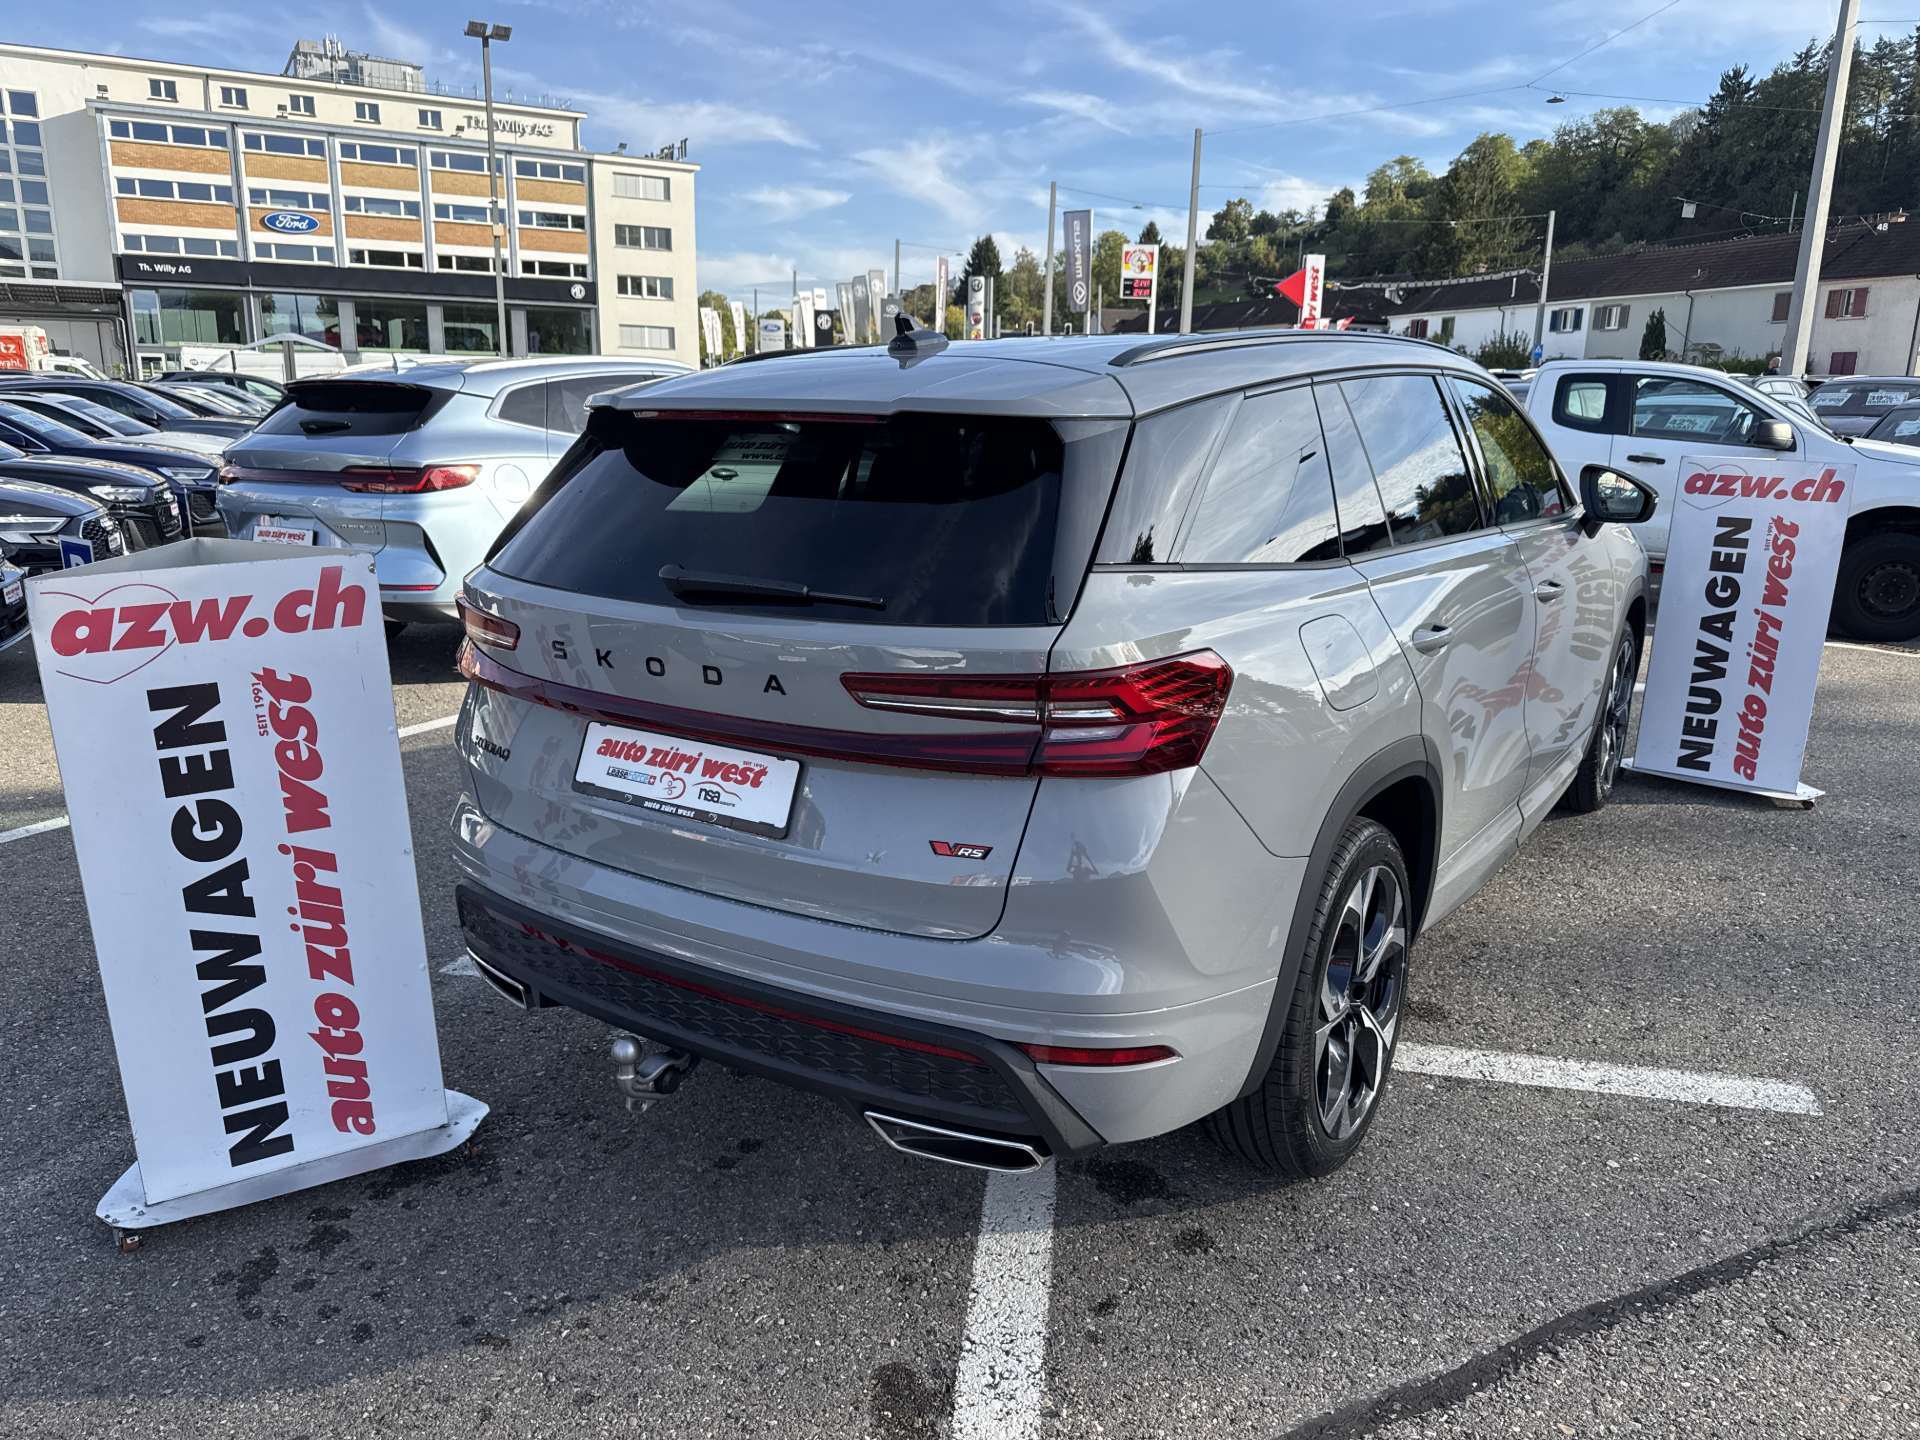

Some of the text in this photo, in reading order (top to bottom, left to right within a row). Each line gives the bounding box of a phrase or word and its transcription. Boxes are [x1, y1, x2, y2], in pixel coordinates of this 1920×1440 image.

[494, 119, 526, 138] Willy
[275, 214, 310, 230] Ford
[1876, 222, 1889, 231] 48
[138, 262, 192, 275] Th. Willy AG
[1684, 469, 1845, 503] azw.ch
[50, 565, 367, 657] azw.ch
[551, 639, 787, 696] SKODA
[1677, 516, 1753, 772] NEUWAGEN
[1733, 514, 1800, 782] auto züri west
[252, 681, 269, 737] SEIT 1991
[596, 738, 769, 789] auto züri west
[643, 800, 661, 810] auto
[677, 808, 695, 818] west
[697, 787, 721, 804] nsa
[146, 681, 295, 1168] NEUWAGEN
[250, 666, 376, 1136] auto züri west
